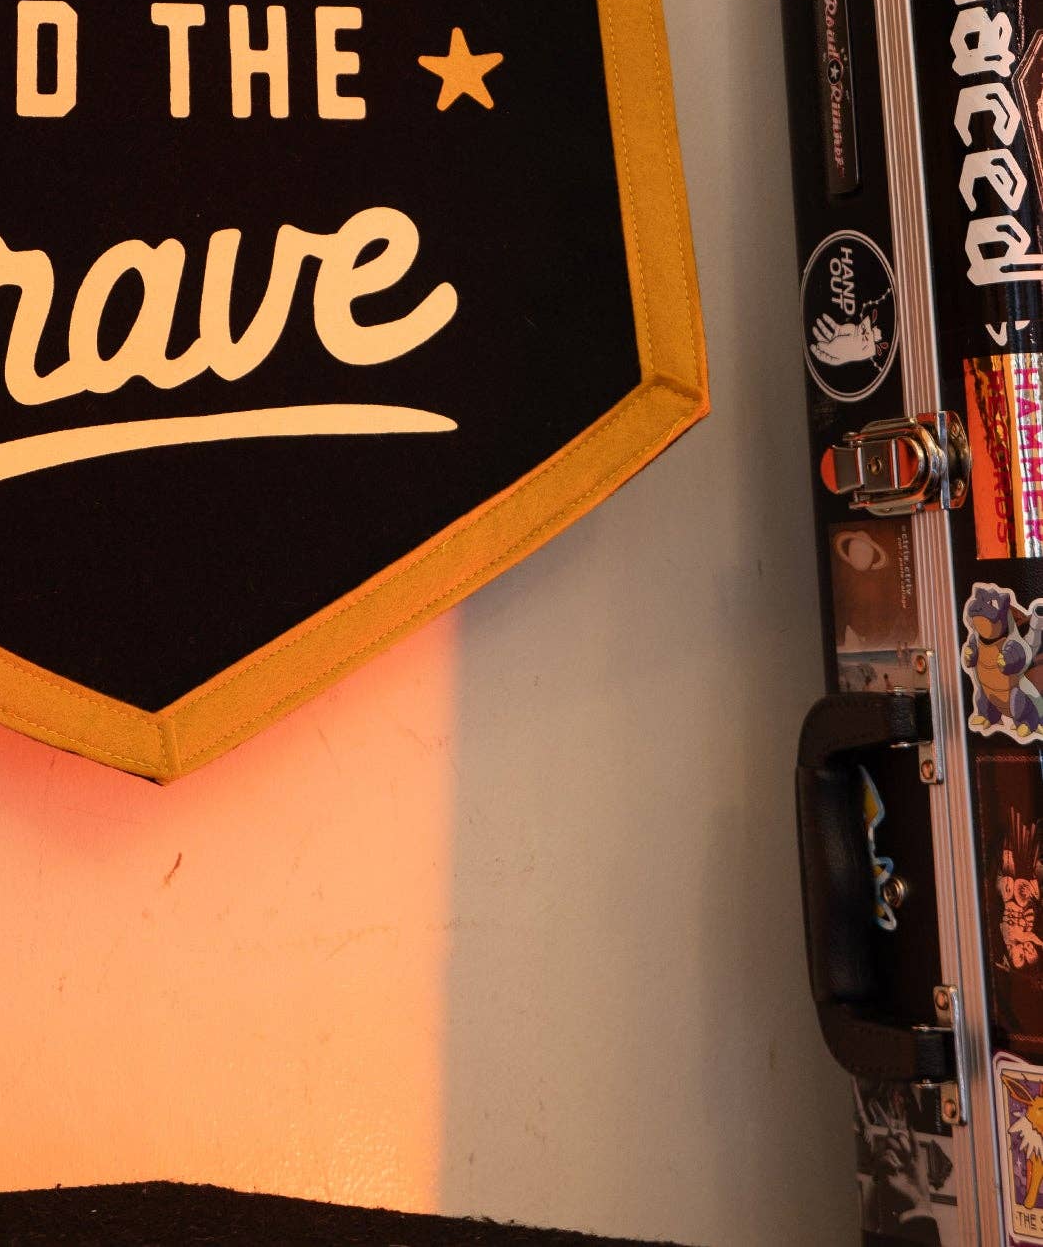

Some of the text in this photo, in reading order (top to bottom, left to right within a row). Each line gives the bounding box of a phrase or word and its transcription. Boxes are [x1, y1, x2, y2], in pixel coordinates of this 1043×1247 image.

[150, 2, 366, 120] THE
[829, 257, 845, 310] OUT
[840, 246, 856, 316] HAND
[987, 369, 1015, 544] RECORDS
[1013, 367, 1043, 544] HAMMER
[1016, 1210, 1038, 1231] THE
